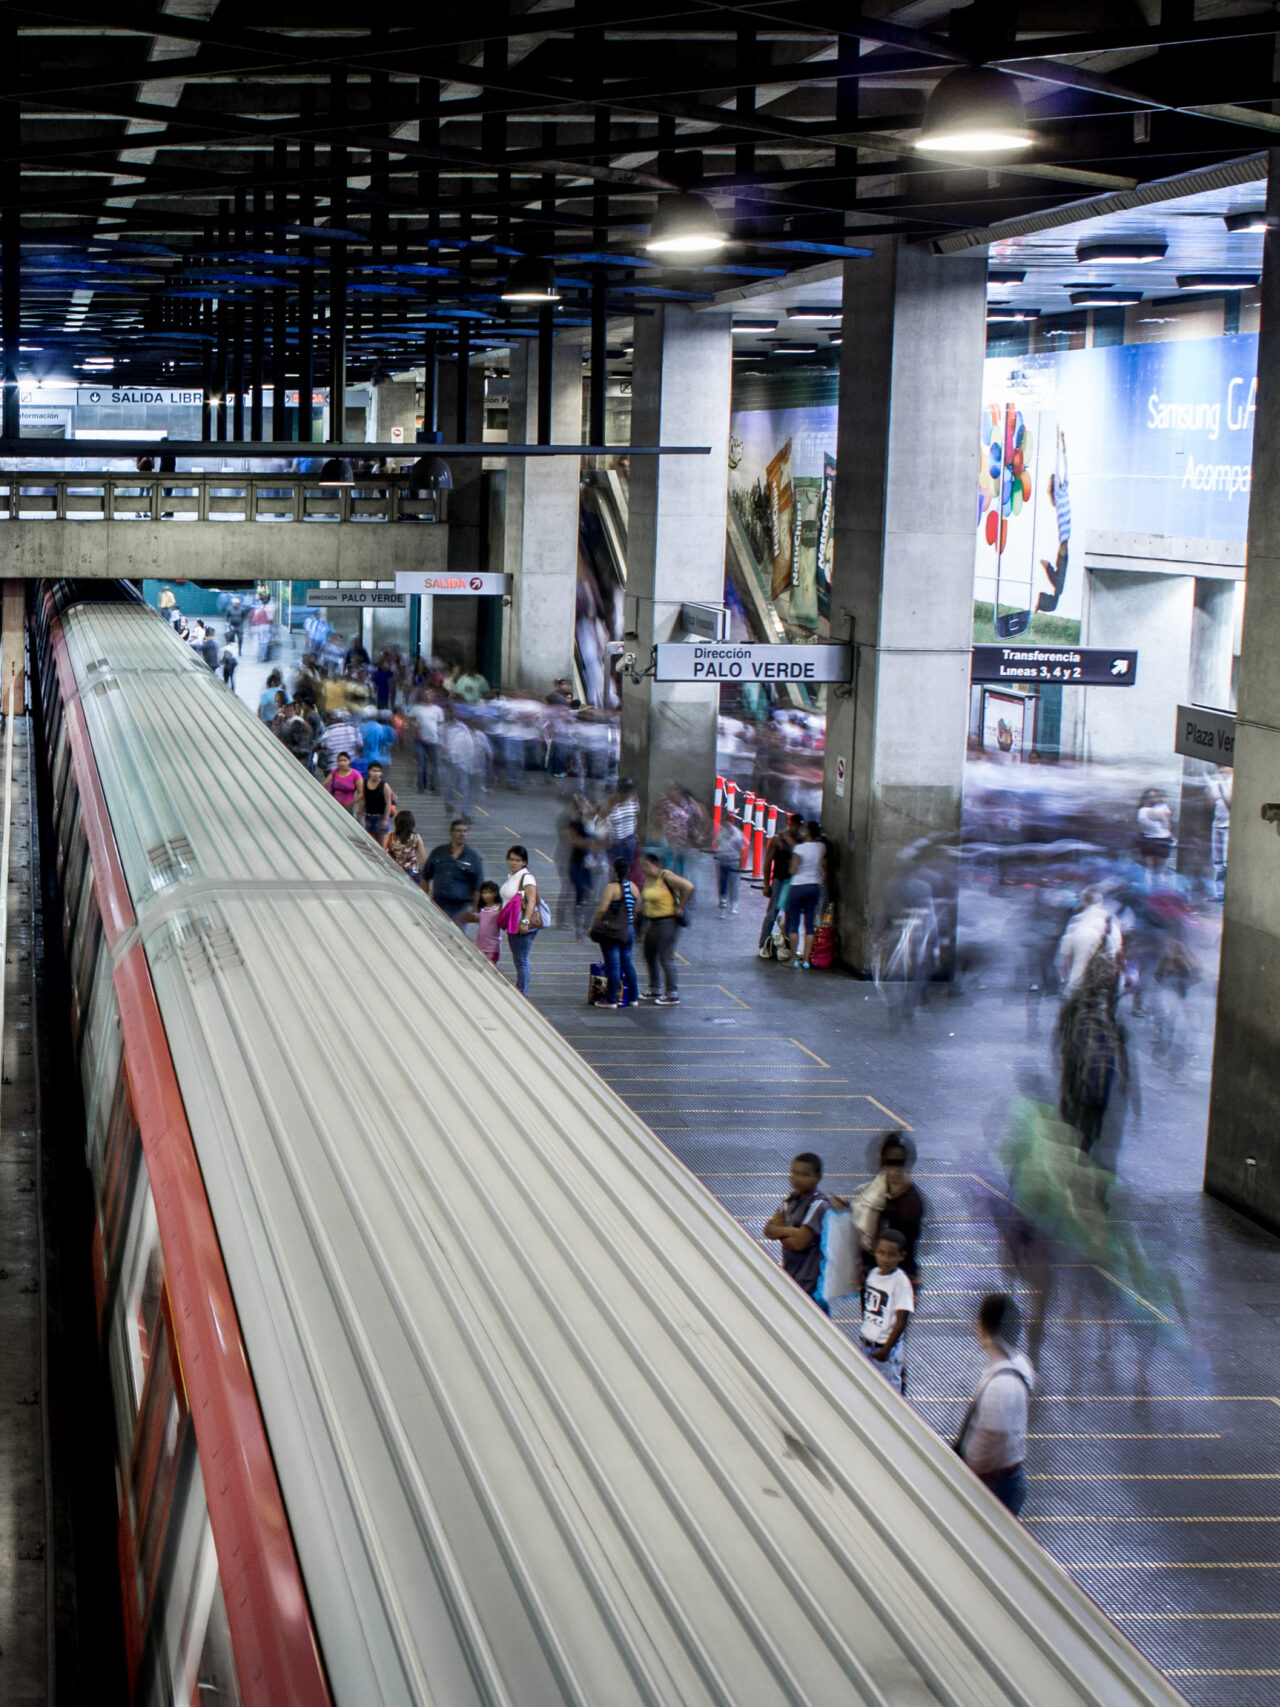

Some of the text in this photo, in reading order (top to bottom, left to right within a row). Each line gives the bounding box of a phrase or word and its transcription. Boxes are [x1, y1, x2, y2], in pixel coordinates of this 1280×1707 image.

[111, 392, 163, 403] SALIDA
[1147, 394, 1220, 440] Samsung
[1182, 455, 1252, 501] Acompa
[424, 578, 466, 588] SALIDA
[341, 593, 367, 602] PALO
[371, 594, 404, 603] VERDE
[694, 648, 751, 659] Dirección
[1002, 649, 1081, 662] Transferencia
[694, 663, 815, 678] PALO VERDE
[1053, 667, 1062, 677] 4
[1063, 669, 1072, 679] y
[1073, 667, 1082, 678] 2
[1186, 722, 1214, 747] Plaza
